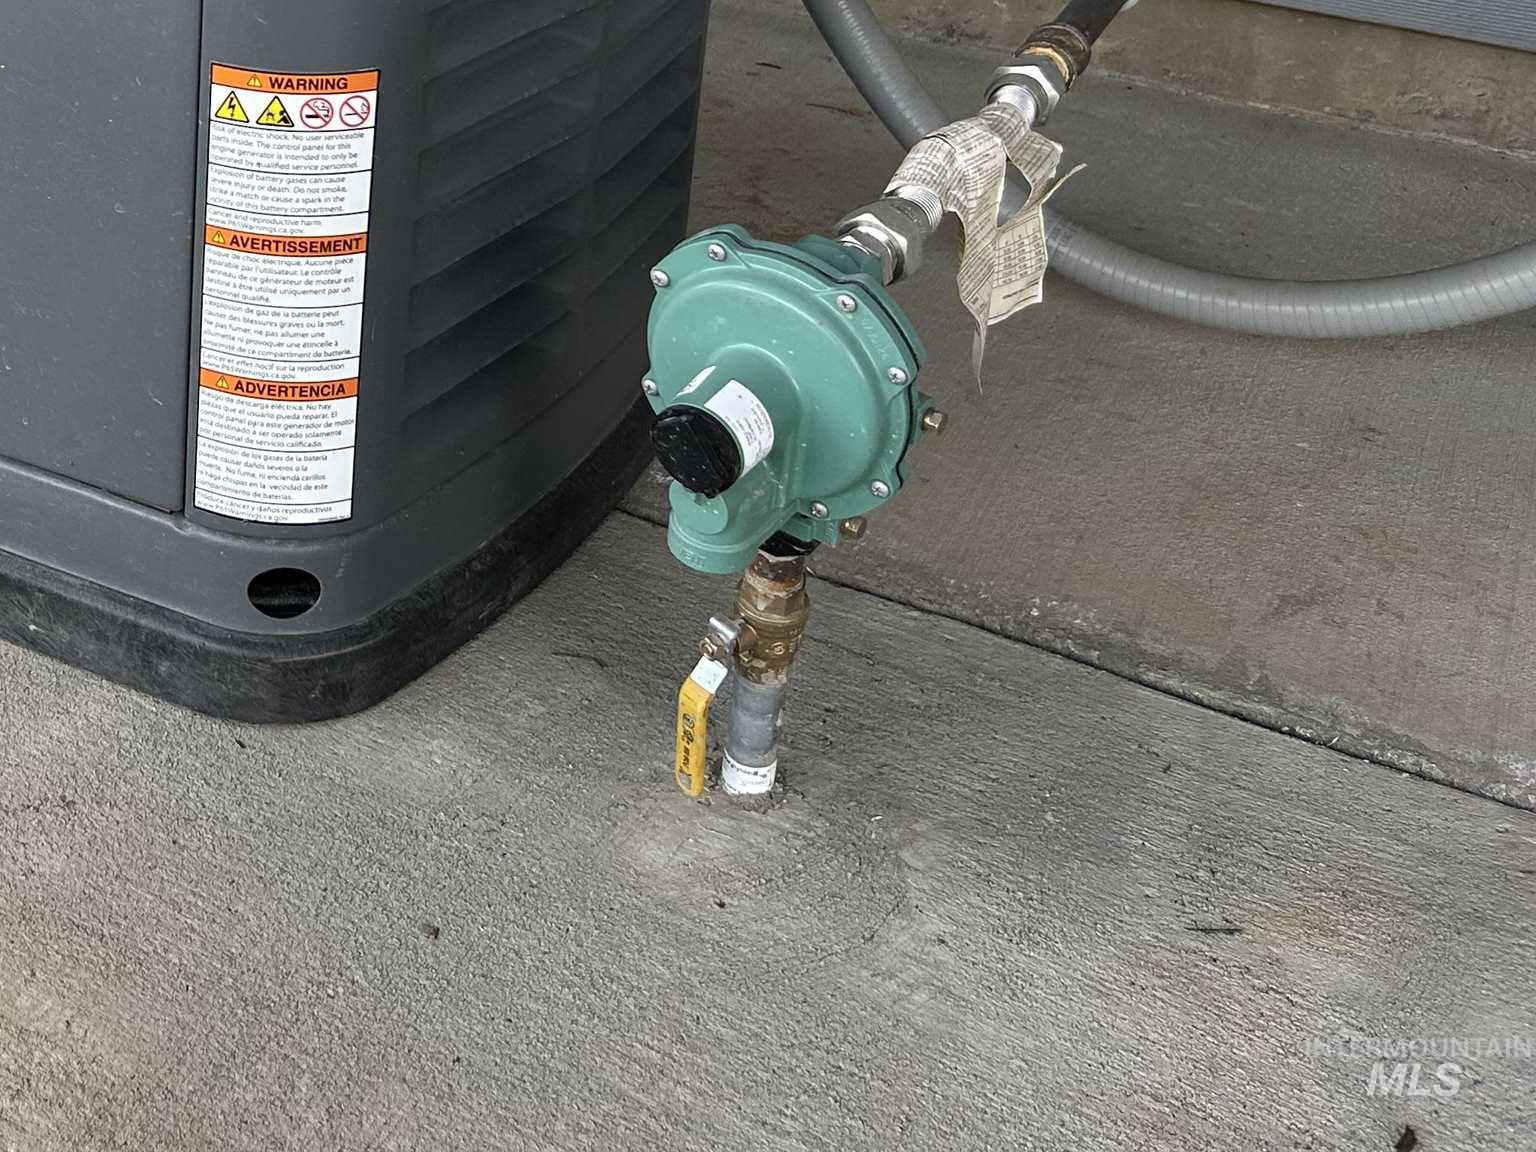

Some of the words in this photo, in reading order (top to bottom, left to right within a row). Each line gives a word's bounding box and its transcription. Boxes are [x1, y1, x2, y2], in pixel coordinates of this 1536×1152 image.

[269, 77, 348, 90] WARNING
[230, 235, 362, 253] AVERTISSEMENT
[234, 380, 346, 397] ADVERTENCIA
